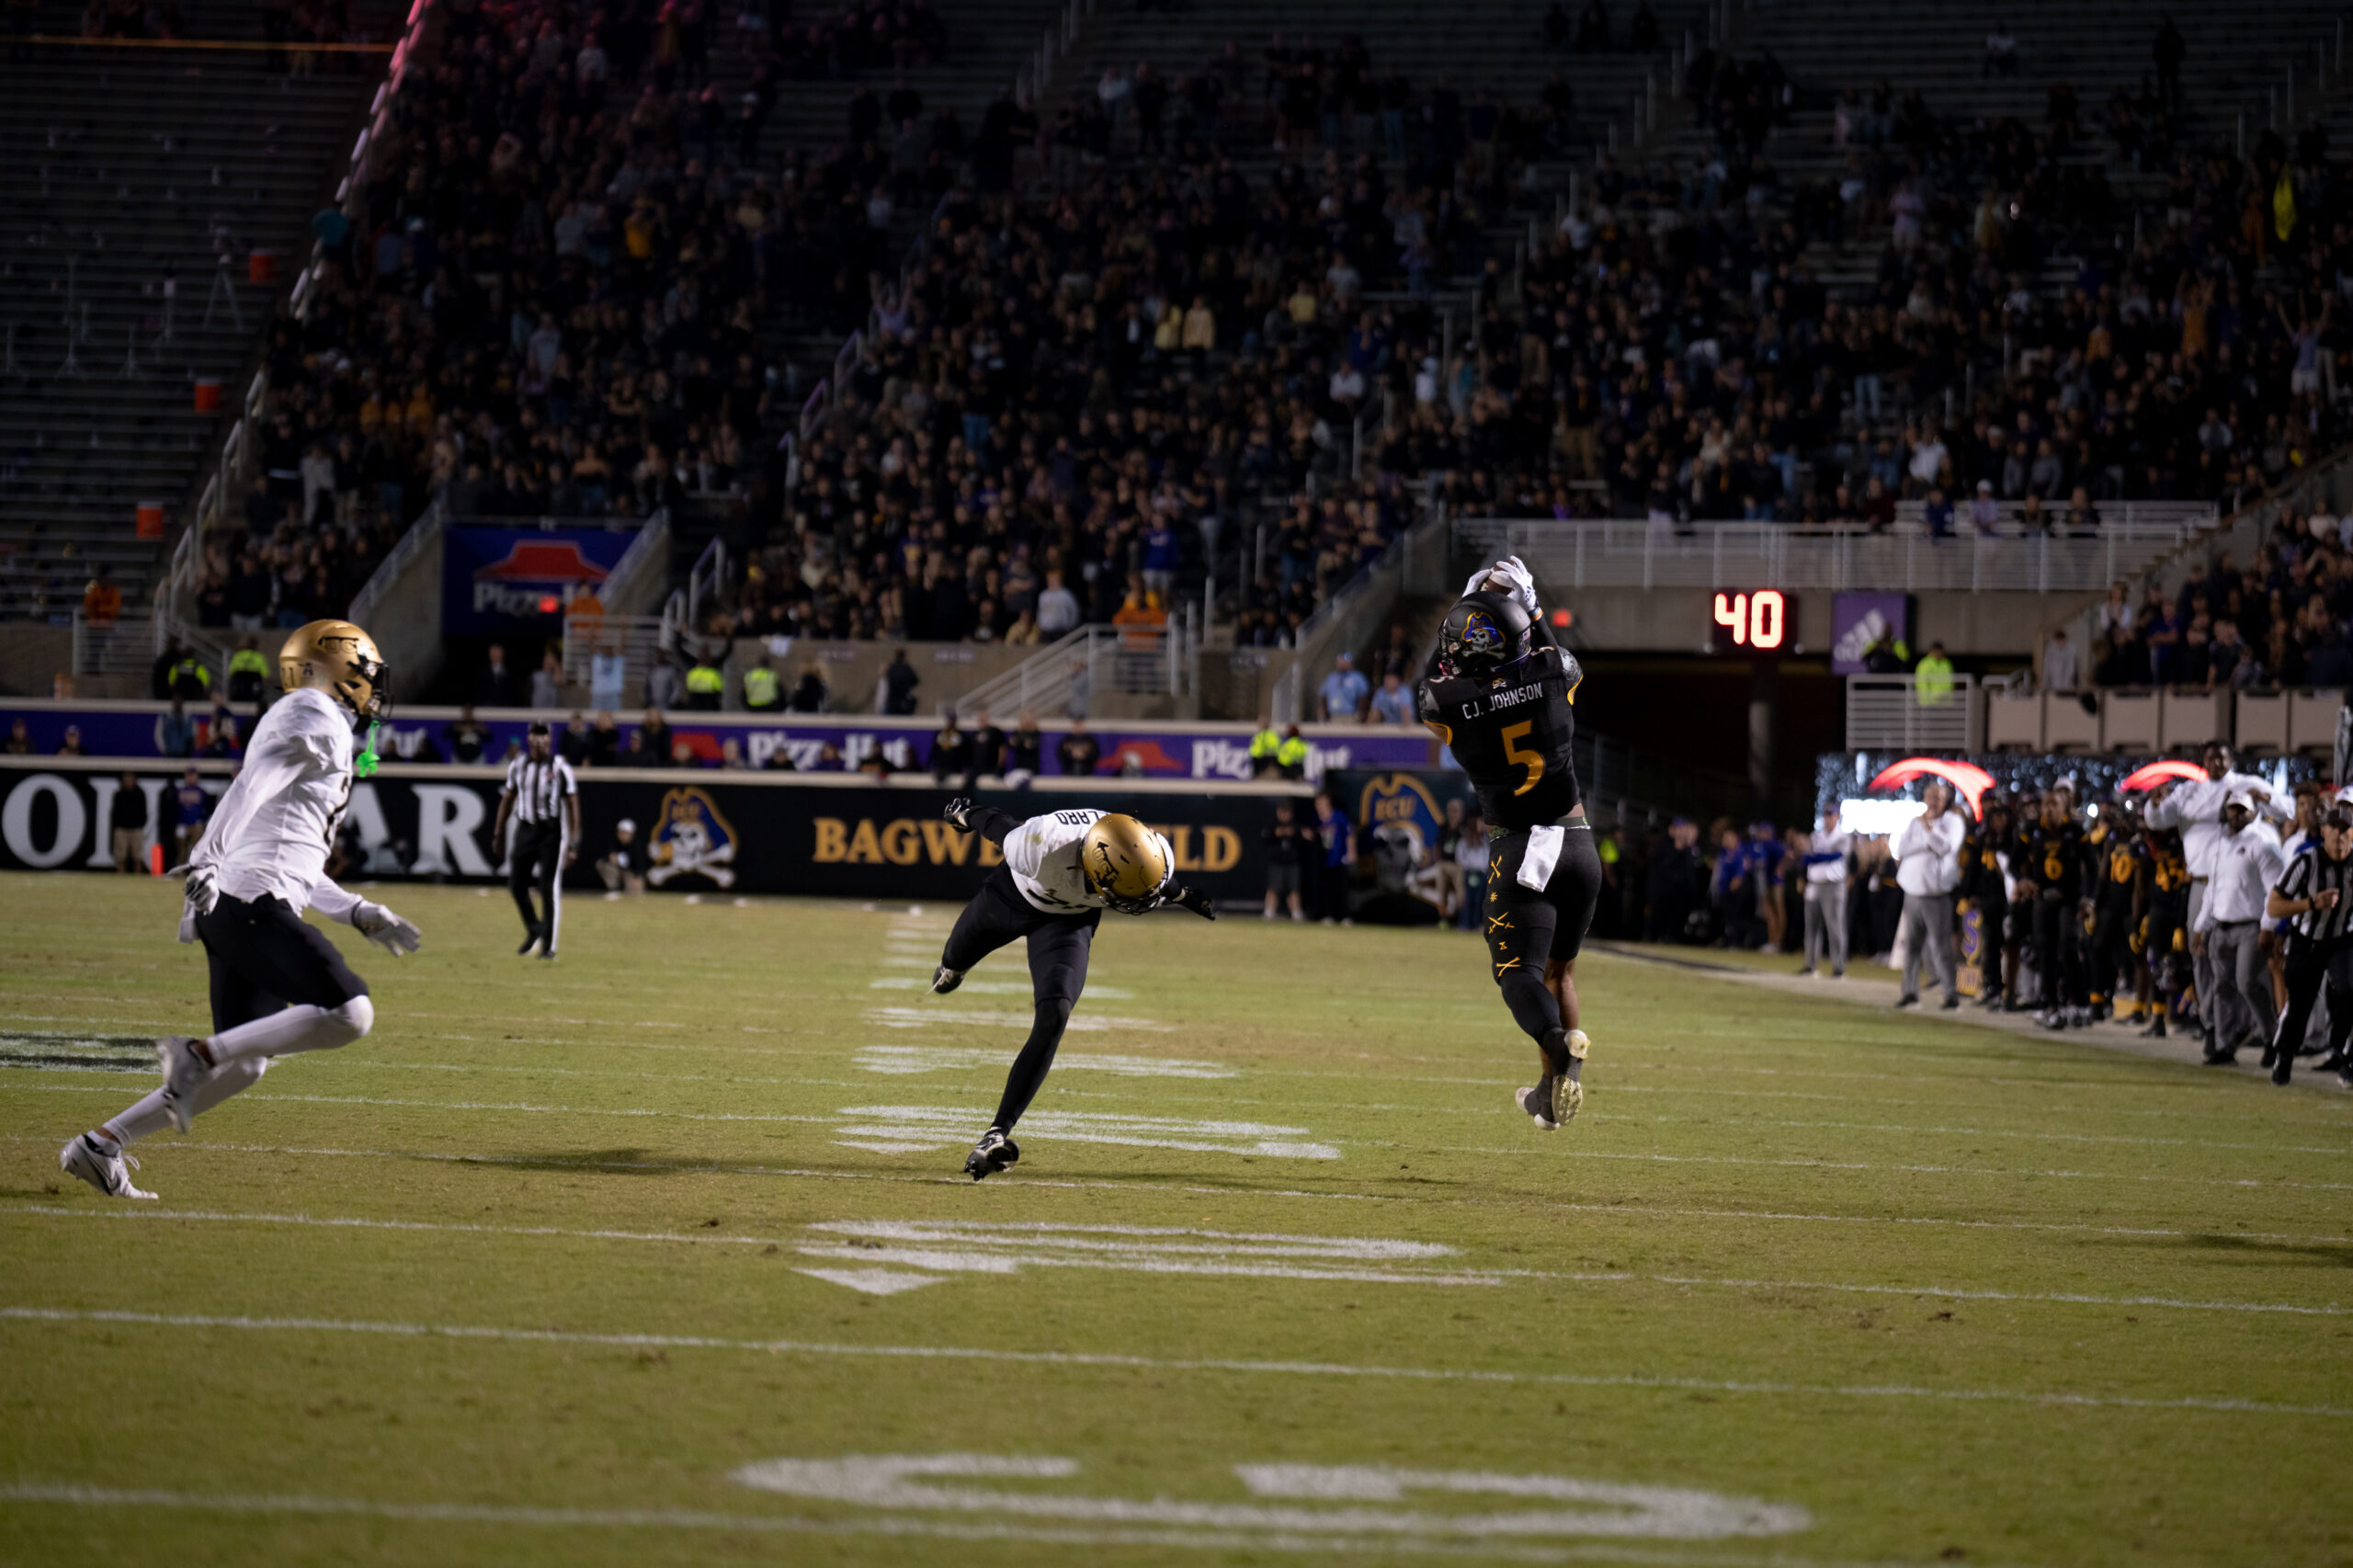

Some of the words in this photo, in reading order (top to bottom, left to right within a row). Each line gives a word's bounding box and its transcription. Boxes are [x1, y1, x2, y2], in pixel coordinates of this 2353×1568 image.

[1714, 589, 1784, 650] 40
[1489, 682, 1544, 711] JOHNSON
[1501, 719, 1545, 797] 5
[1054, 811, 1108, 825] LARD
[2044, 850, 2063, 881] 6
[2110, 851, 2133, 884] 10
